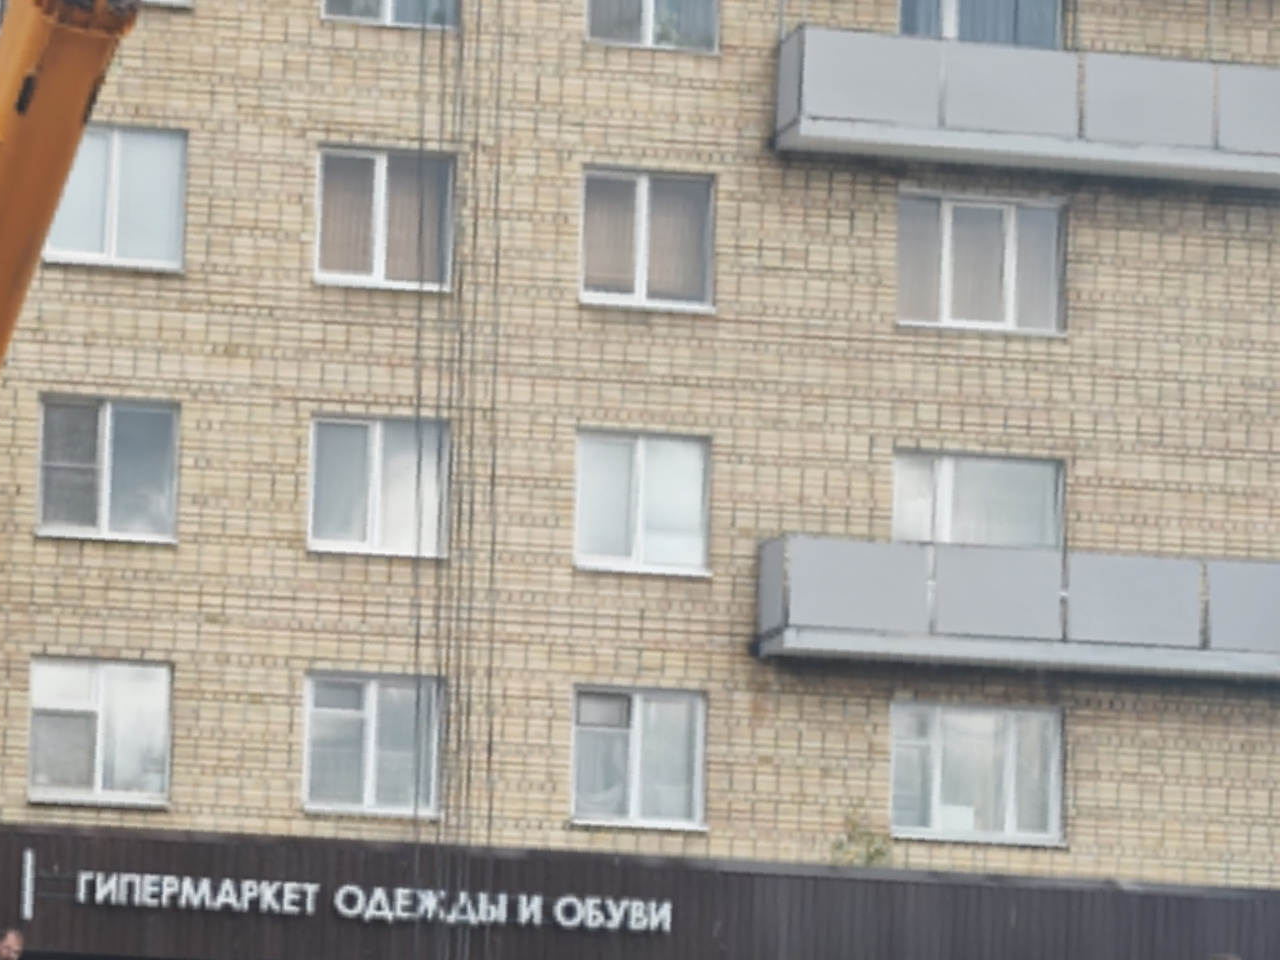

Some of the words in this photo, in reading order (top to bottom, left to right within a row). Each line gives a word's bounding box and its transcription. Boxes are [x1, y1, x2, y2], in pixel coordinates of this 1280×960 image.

[75, 870, 321, 915] ГИПЕРМАРКЕТ
[333, 883, 508, 926] ОДЕЖДЫ
[518, 894, 544, 926] И
[553, 897, 673, 932] ОБУВИ
